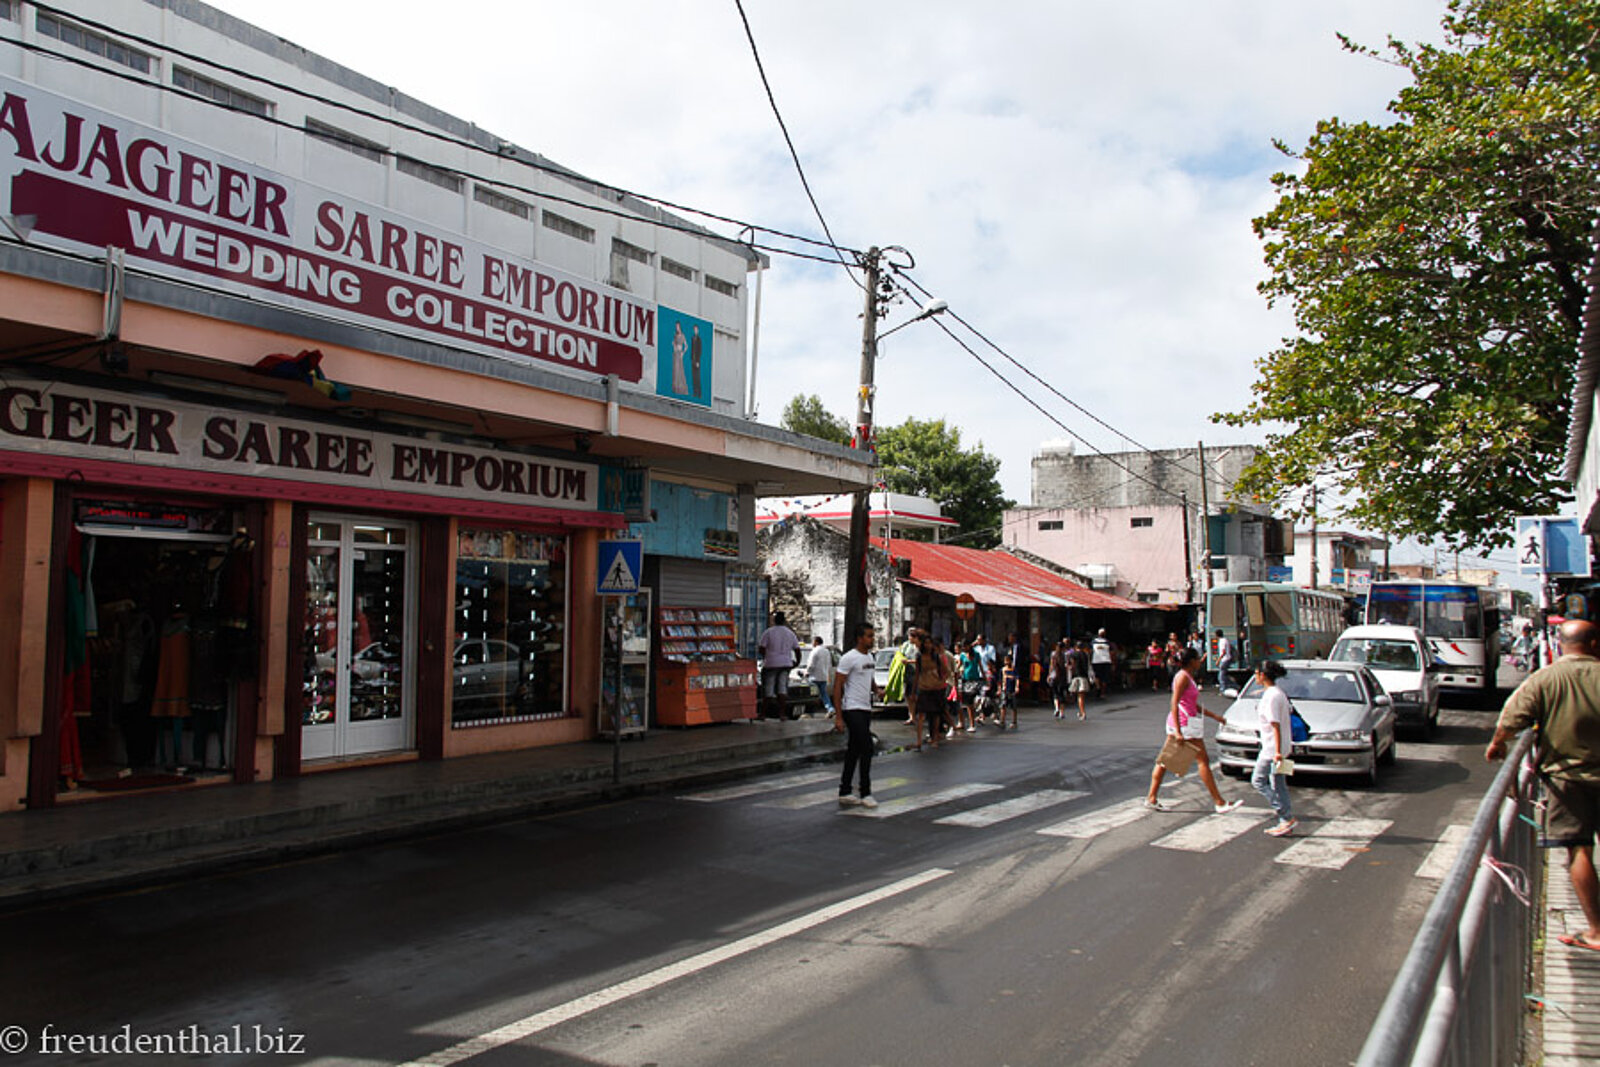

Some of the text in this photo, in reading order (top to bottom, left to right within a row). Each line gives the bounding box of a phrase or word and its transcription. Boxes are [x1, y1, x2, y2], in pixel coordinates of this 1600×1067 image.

[0, 92, 656, 346] AJAGEER SAREE EMPORIUM
[127, 208, 598, 367] WEDDING COLLECTION
[0, 387, 587, 501] GEER SAREE EMPORIUM
